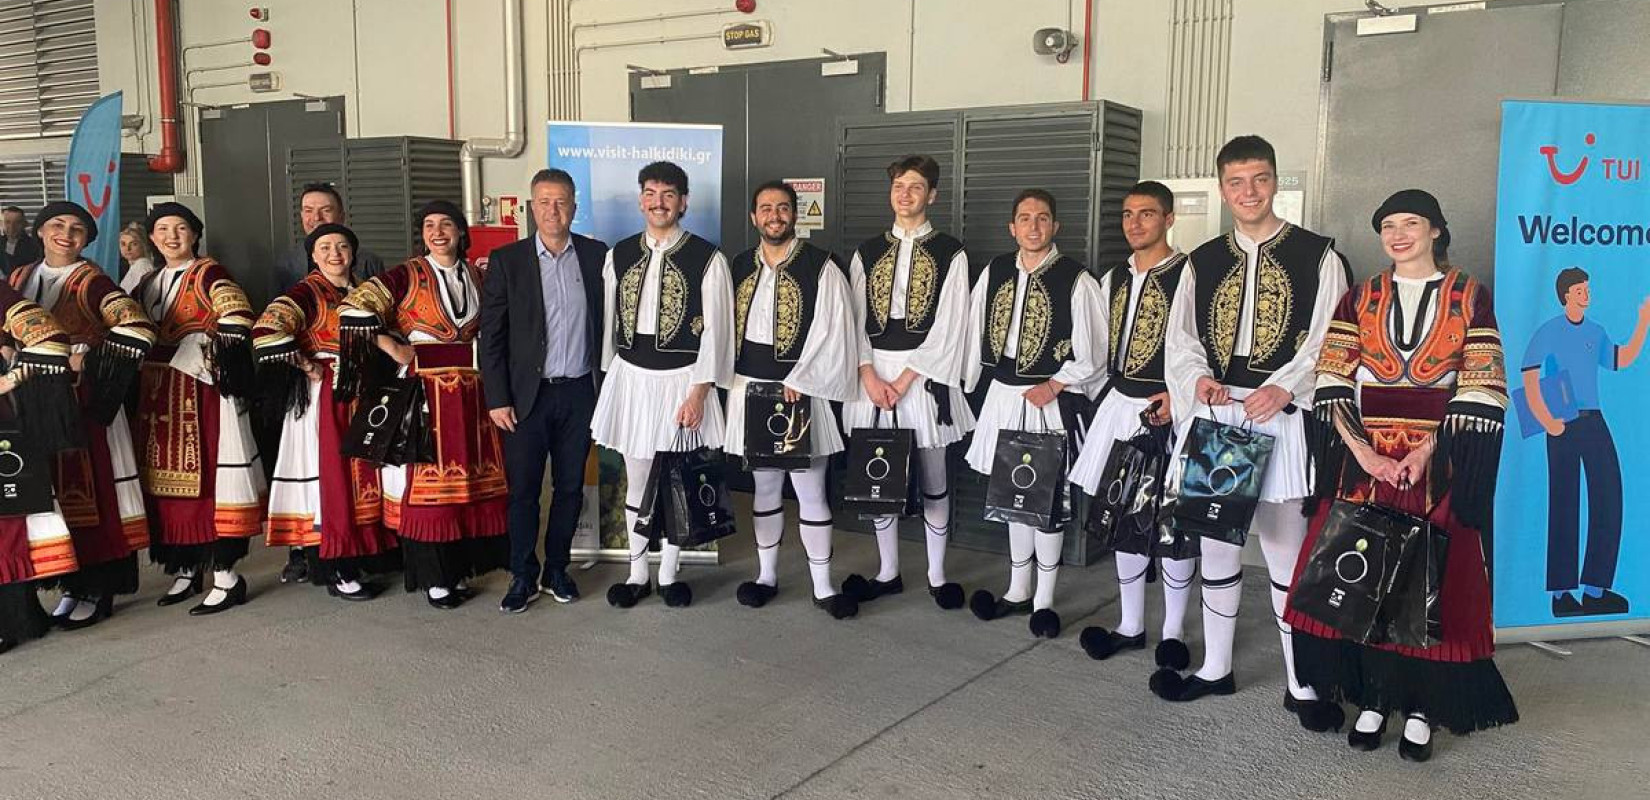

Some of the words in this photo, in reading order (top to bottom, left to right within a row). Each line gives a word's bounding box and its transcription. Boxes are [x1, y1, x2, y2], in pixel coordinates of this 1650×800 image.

[725, 30, 744, 40] STOP
[744, 29, 760, 38] GAS
[557, 146, 712, 164] www.visit-halkidiki.gr
[1601, 158, 1640, 180] TUI
[1517, 215, 1650, 246] Welcom
